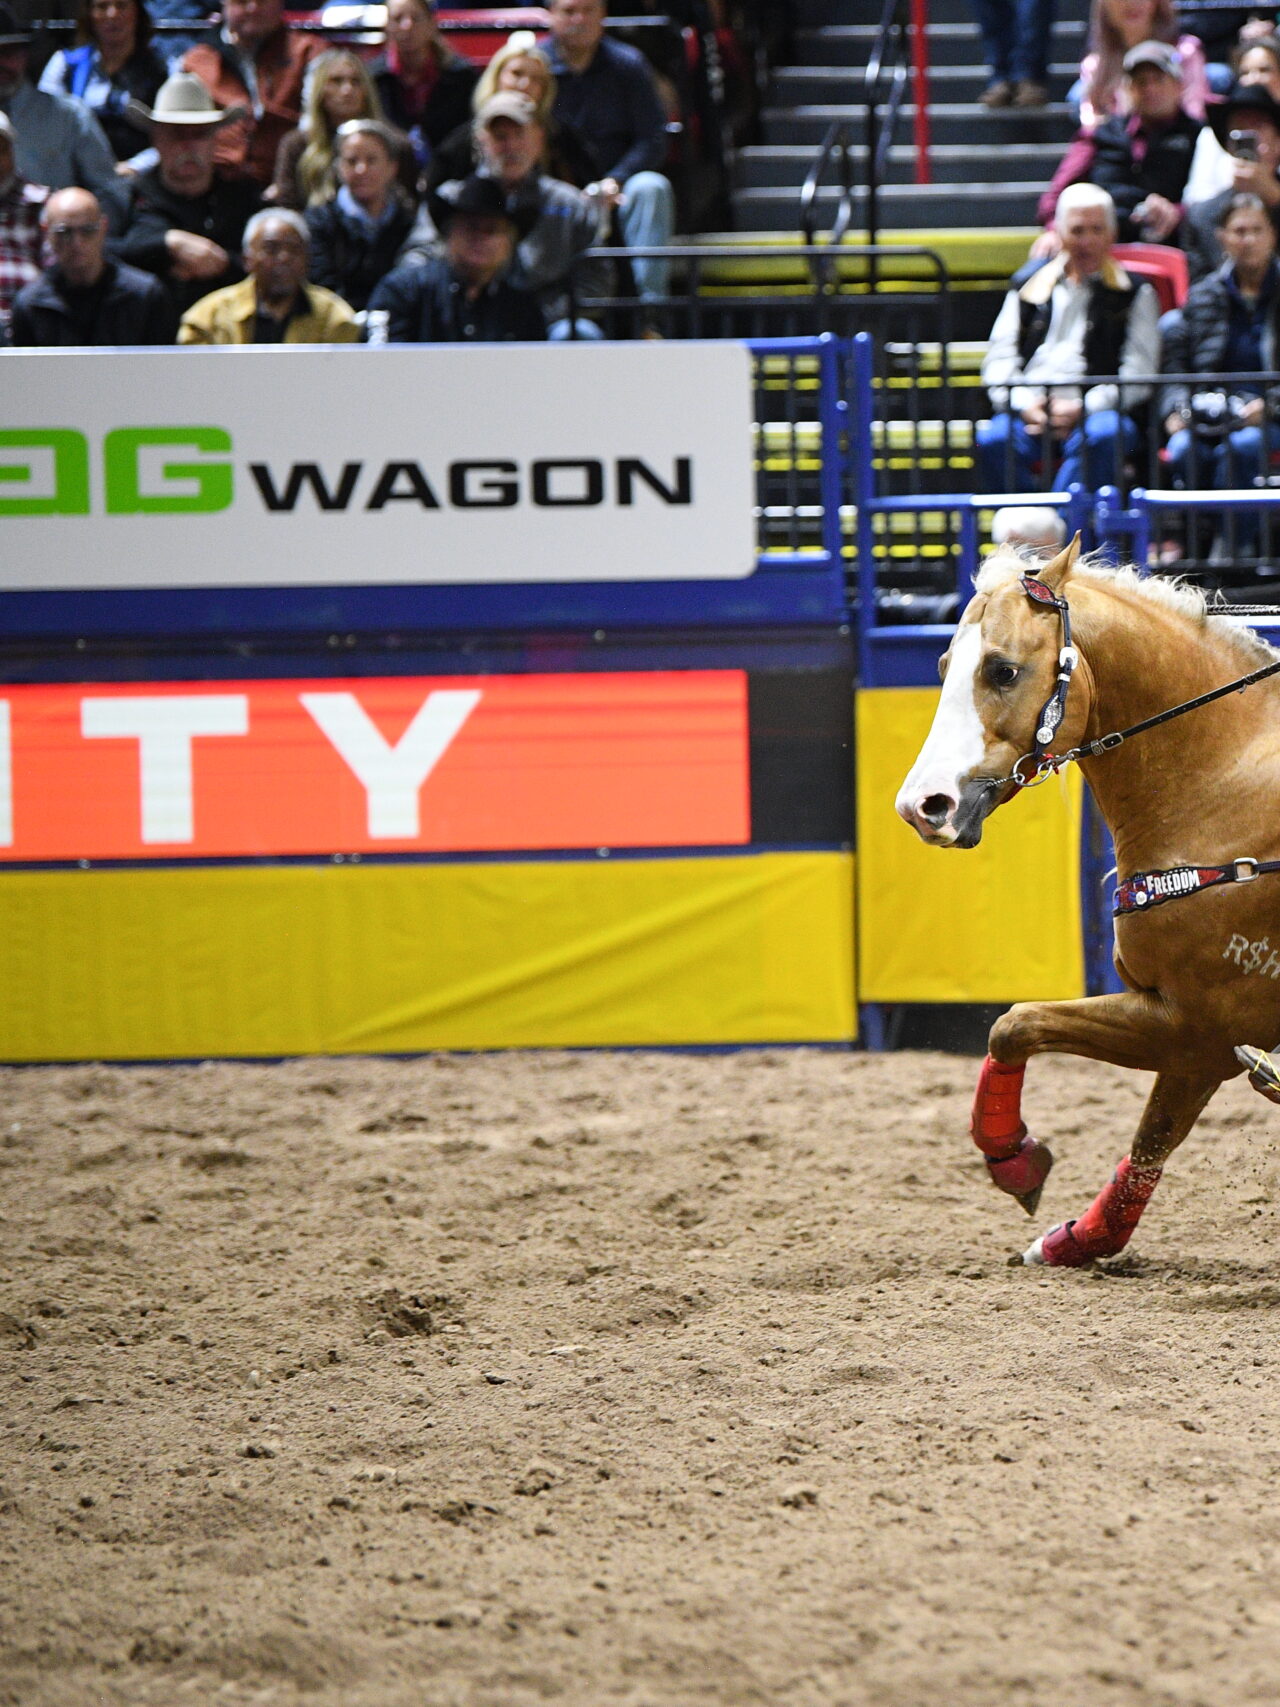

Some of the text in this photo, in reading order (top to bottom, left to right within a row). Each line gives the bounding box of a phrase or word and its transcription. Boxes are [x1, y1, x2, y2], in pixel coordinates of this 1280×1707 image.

[248, 456, 694, 512] WAGON
[0, 689, 483, 847] TY
[1145, 869, 1200, 899] FREEDOM
